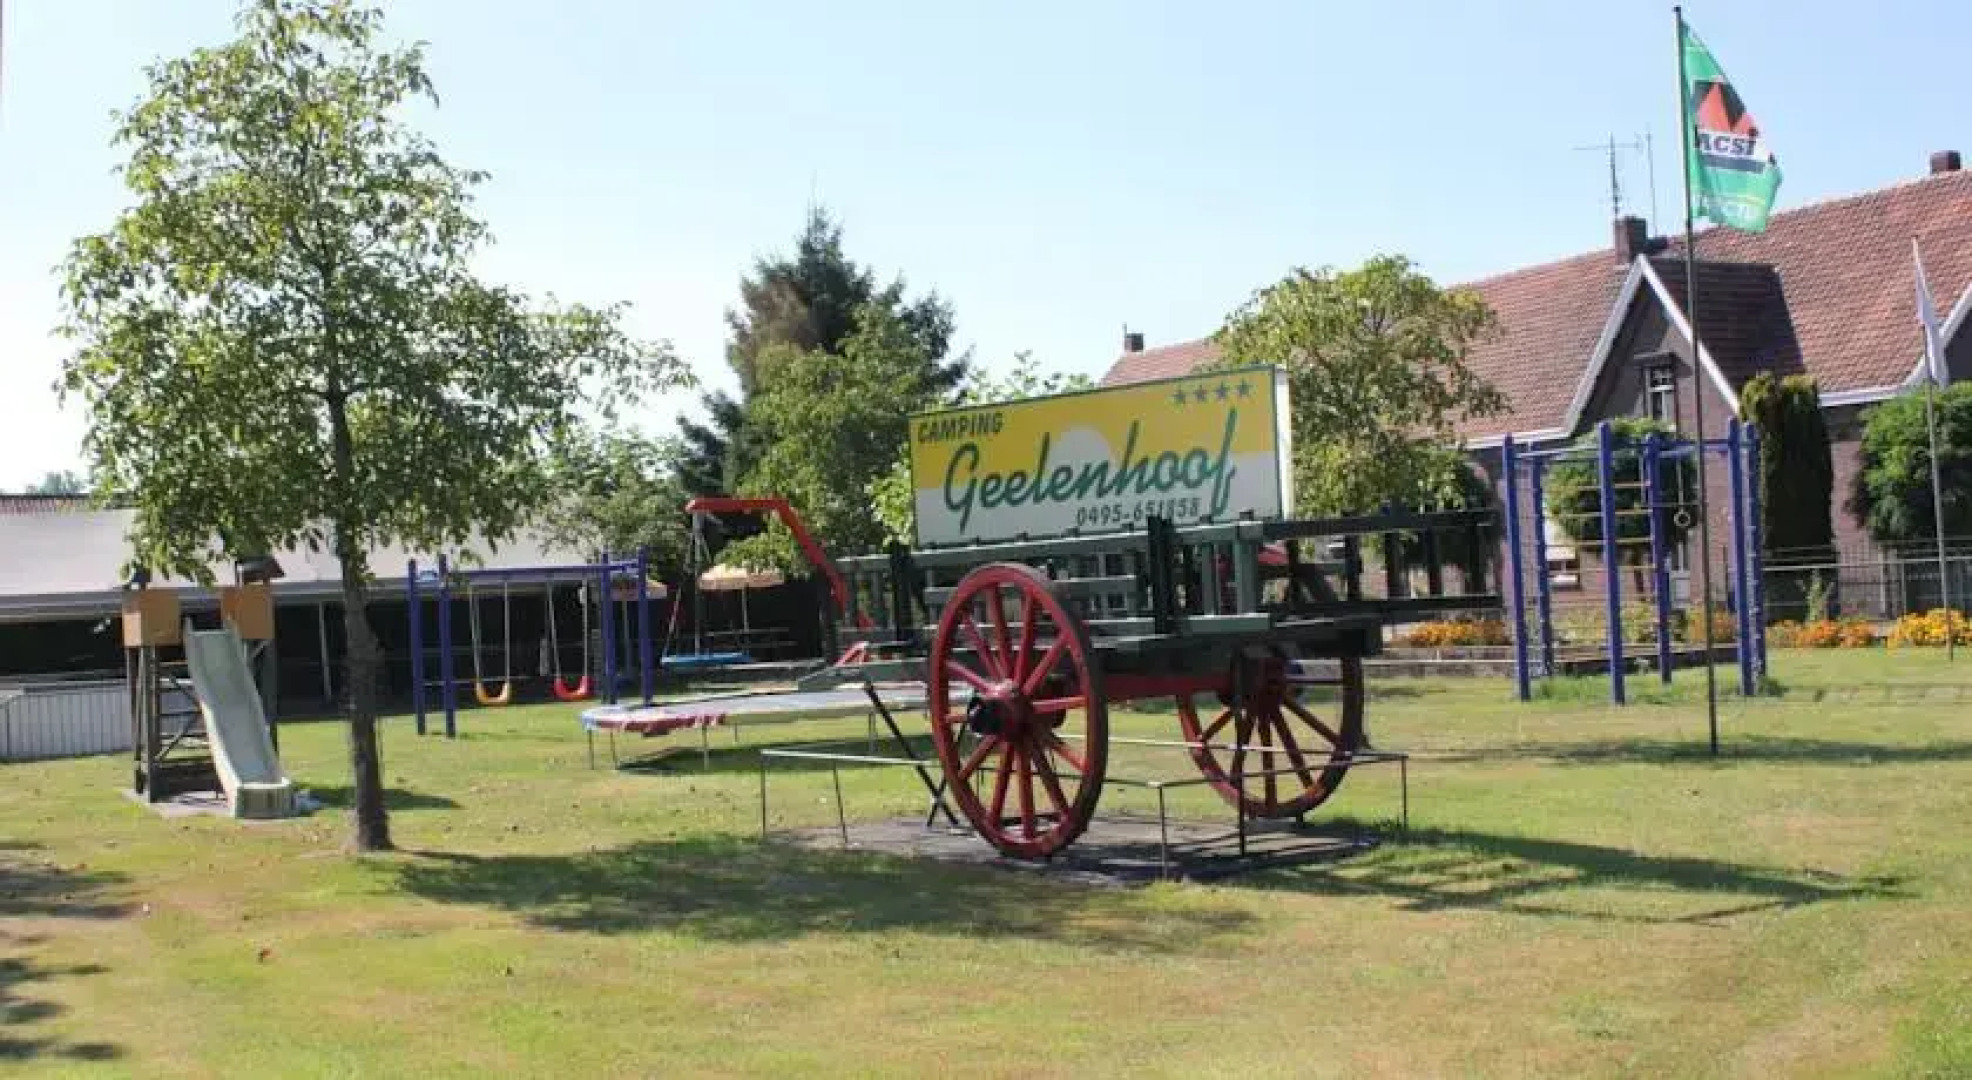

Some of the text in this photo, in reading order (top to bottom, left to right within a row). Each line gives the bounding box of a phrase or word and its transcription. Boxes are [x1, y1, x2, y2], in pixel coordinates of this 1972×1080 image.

[1694, 133, 1757, 156] ACSI
[918, 412, 1004, 444] CAMPING
[943, 407, 1237, 535] Geelenhoof
